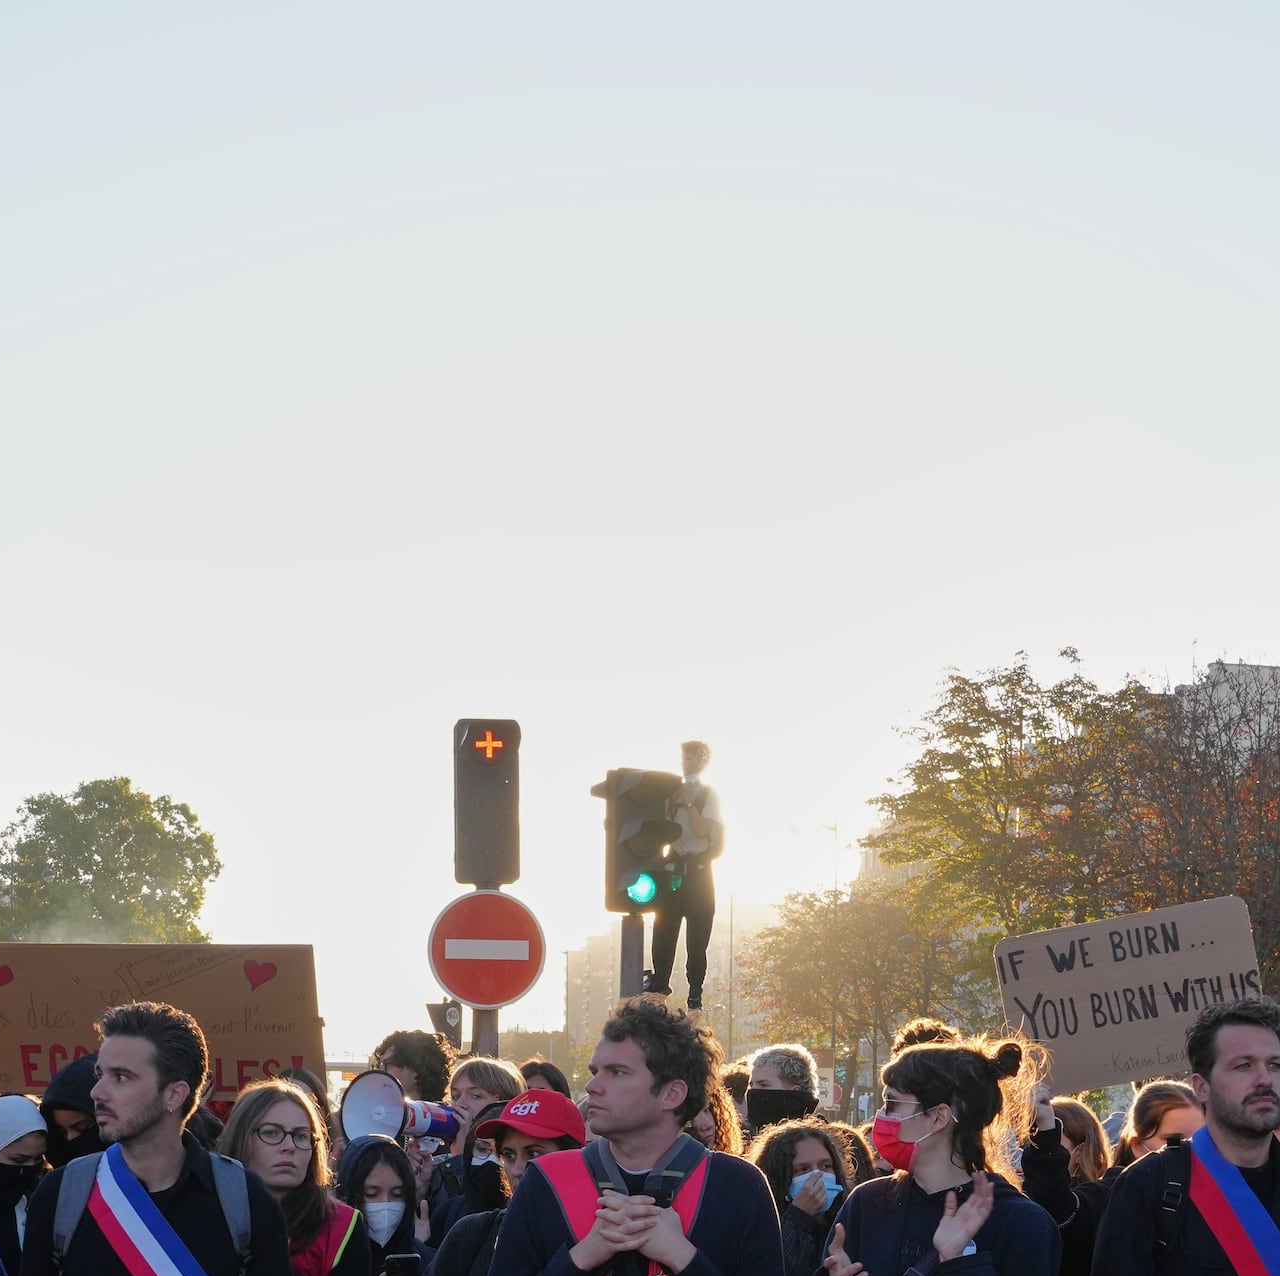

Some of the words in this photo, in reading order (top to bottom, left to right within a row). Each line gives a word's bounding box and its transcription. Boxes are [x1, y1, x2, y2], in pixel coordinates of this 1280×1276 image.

[998, 950, 1025, 984] IF
[1046, 937, 1094, 973] WE
[1014, 992, 1078, 1042] YOU
[1090, 984, 1159, 1029] BURN
[1229, 969, 1263, 1003] US
[510, 1100, 540, 1116] cgt
